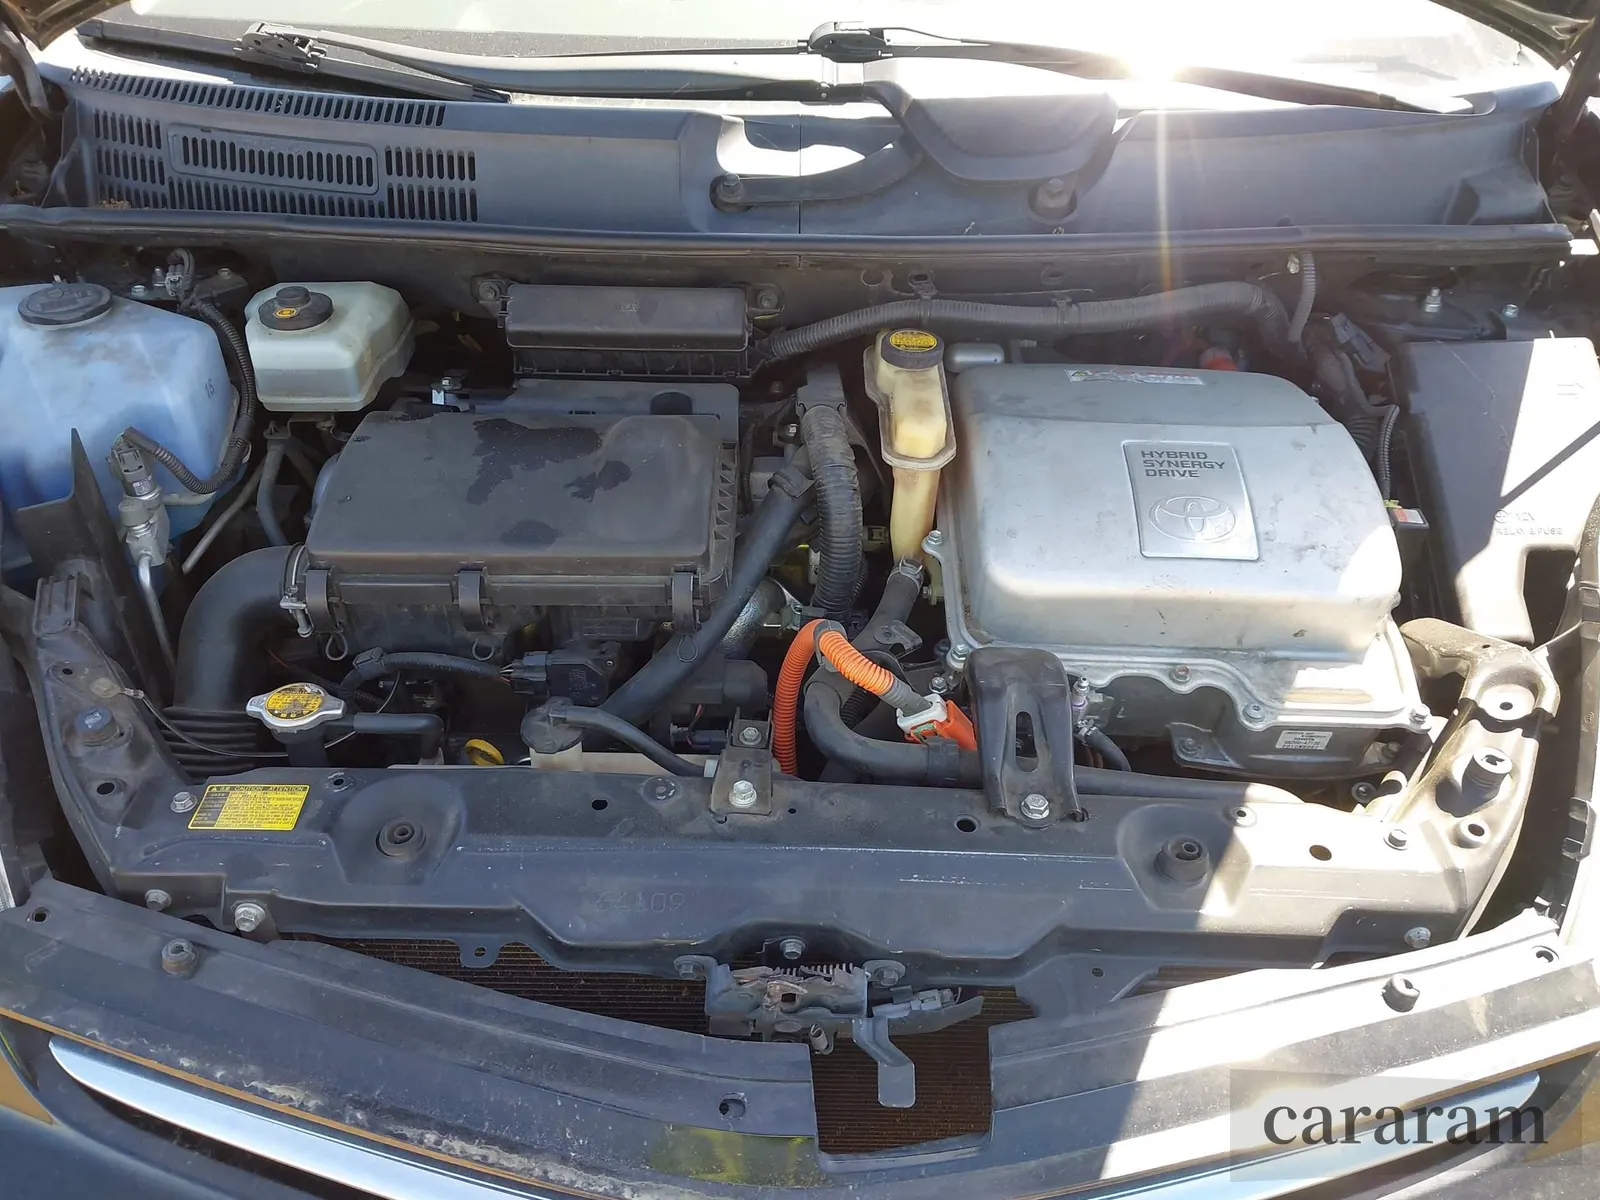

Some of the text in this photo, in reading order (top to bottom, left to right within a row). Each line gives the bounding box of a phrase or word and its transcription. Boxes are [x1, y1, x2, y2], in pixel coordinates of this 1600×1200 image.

[1140, 450, 1208, 460] HYBRID
[1142, 459, 1226, 470] SYNERGY
[1145, 468, 1200, 478] DRIVE
